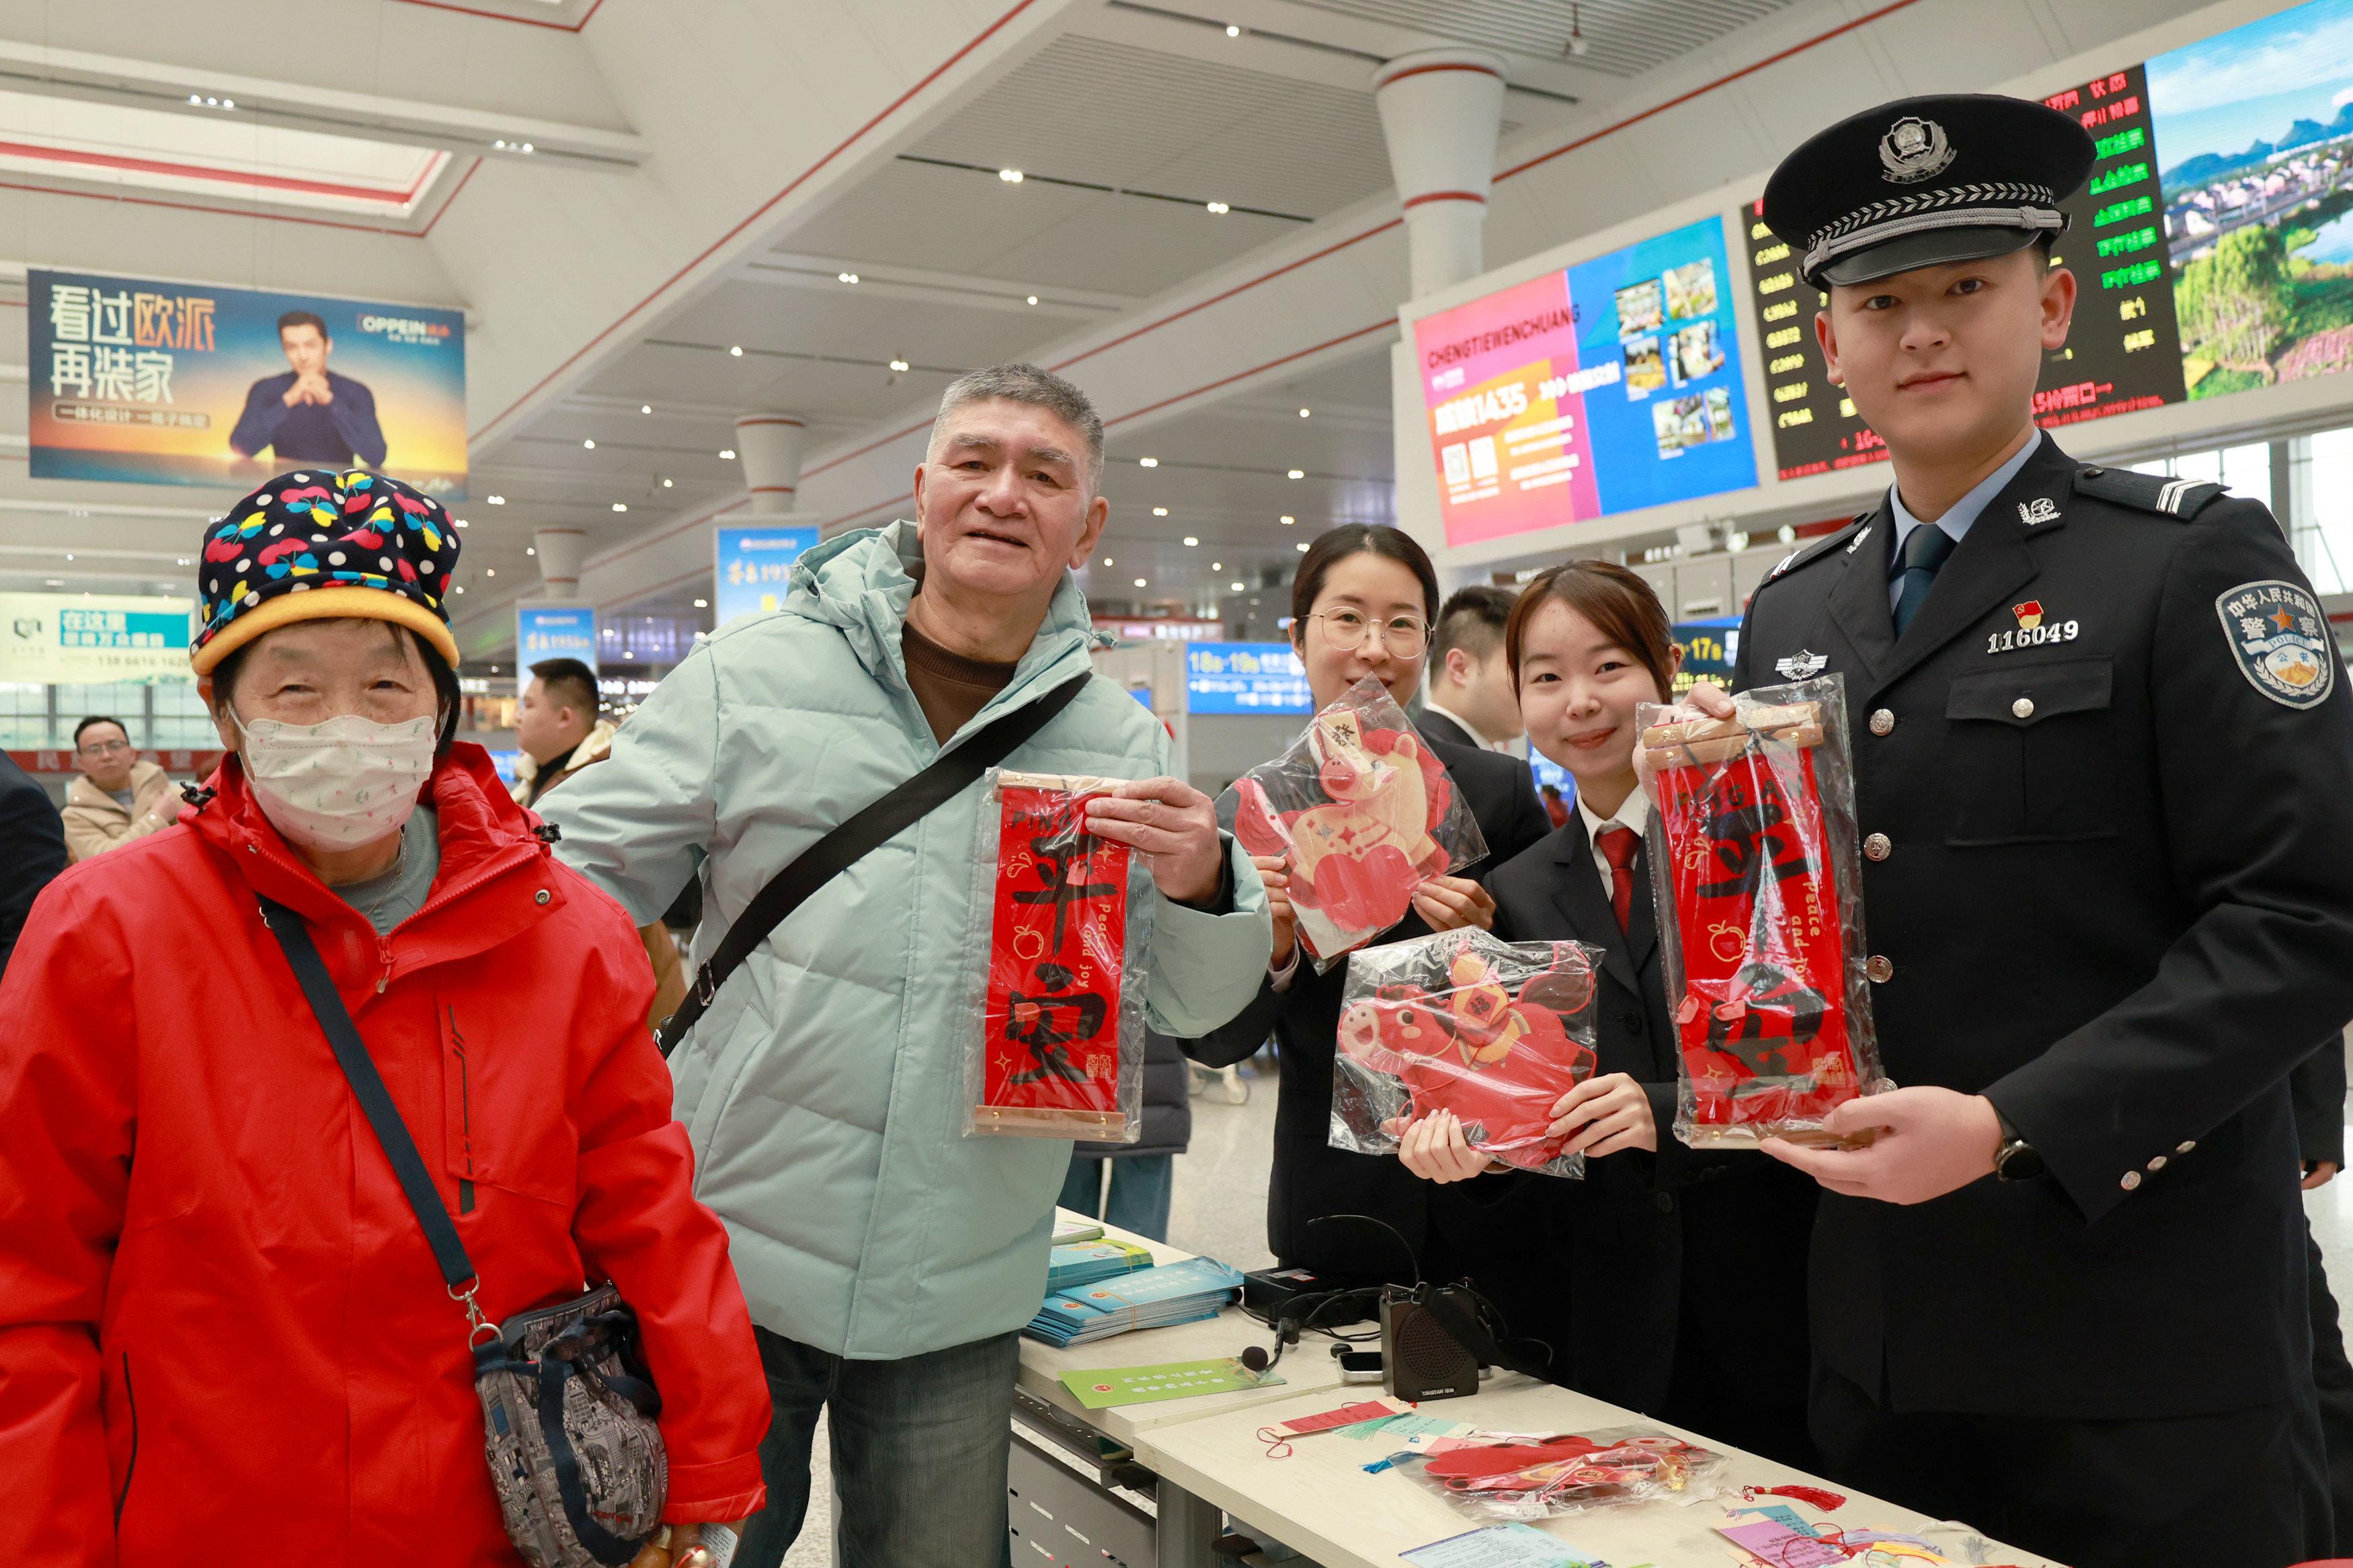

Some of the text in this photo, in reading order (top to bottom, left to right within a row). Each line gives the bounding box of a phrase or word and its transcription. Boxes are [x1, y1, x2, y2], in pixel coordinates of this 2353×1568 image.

[50, 284, 215, 352] 看过欧派
[362, 315, 427, 336] OPPEIN
[50, 342, 173, 404] 再装家
[2227, 587, 2316, 618] 中华人民共和国
[1987, 620, 2079, 654] 116049
[2239, 616, 2319, 640] 警 察
[2268, 635, 2308, 649] POLICE
[1791, 914, 1810, 948] and
[1006, 833, 1119, 1086] 平安
[1077, 929, 1096, 988] and joy
